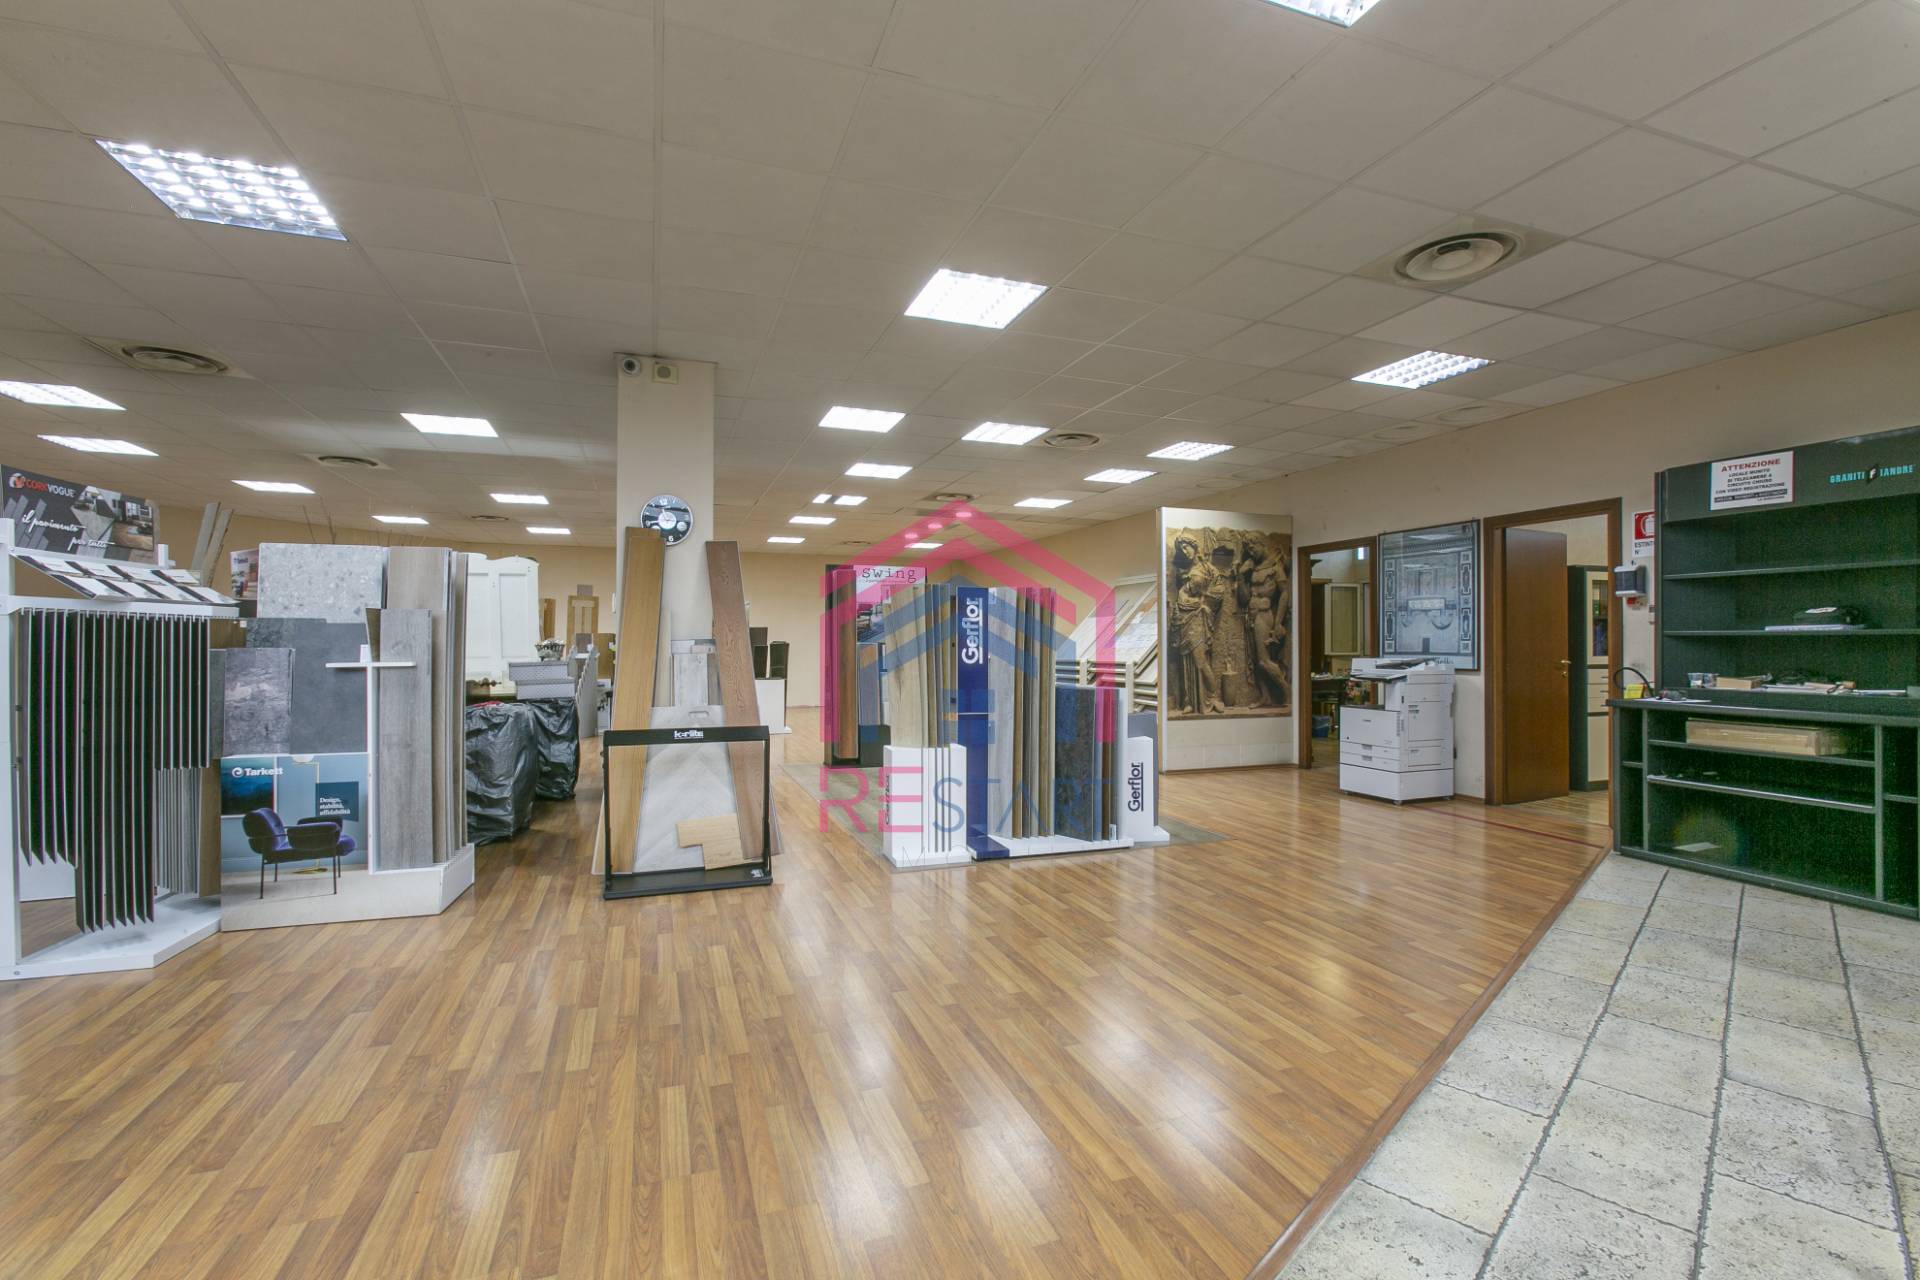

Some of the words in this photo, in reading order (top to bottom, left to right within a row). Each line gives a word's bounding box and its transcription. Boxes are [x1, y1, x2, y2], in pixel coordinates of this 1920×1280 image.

[1721, 458, 1781, 472] ATTENZIONE
[1734, 474, 1767, 482] TELECAMERE
[1829, 471, 1865, 483] GRANITI
[961, 597, 983, 665] Gerflor
[245, 767, 284, 776] Tarkett
[1127, 762, 1144, 812] Gerflor
